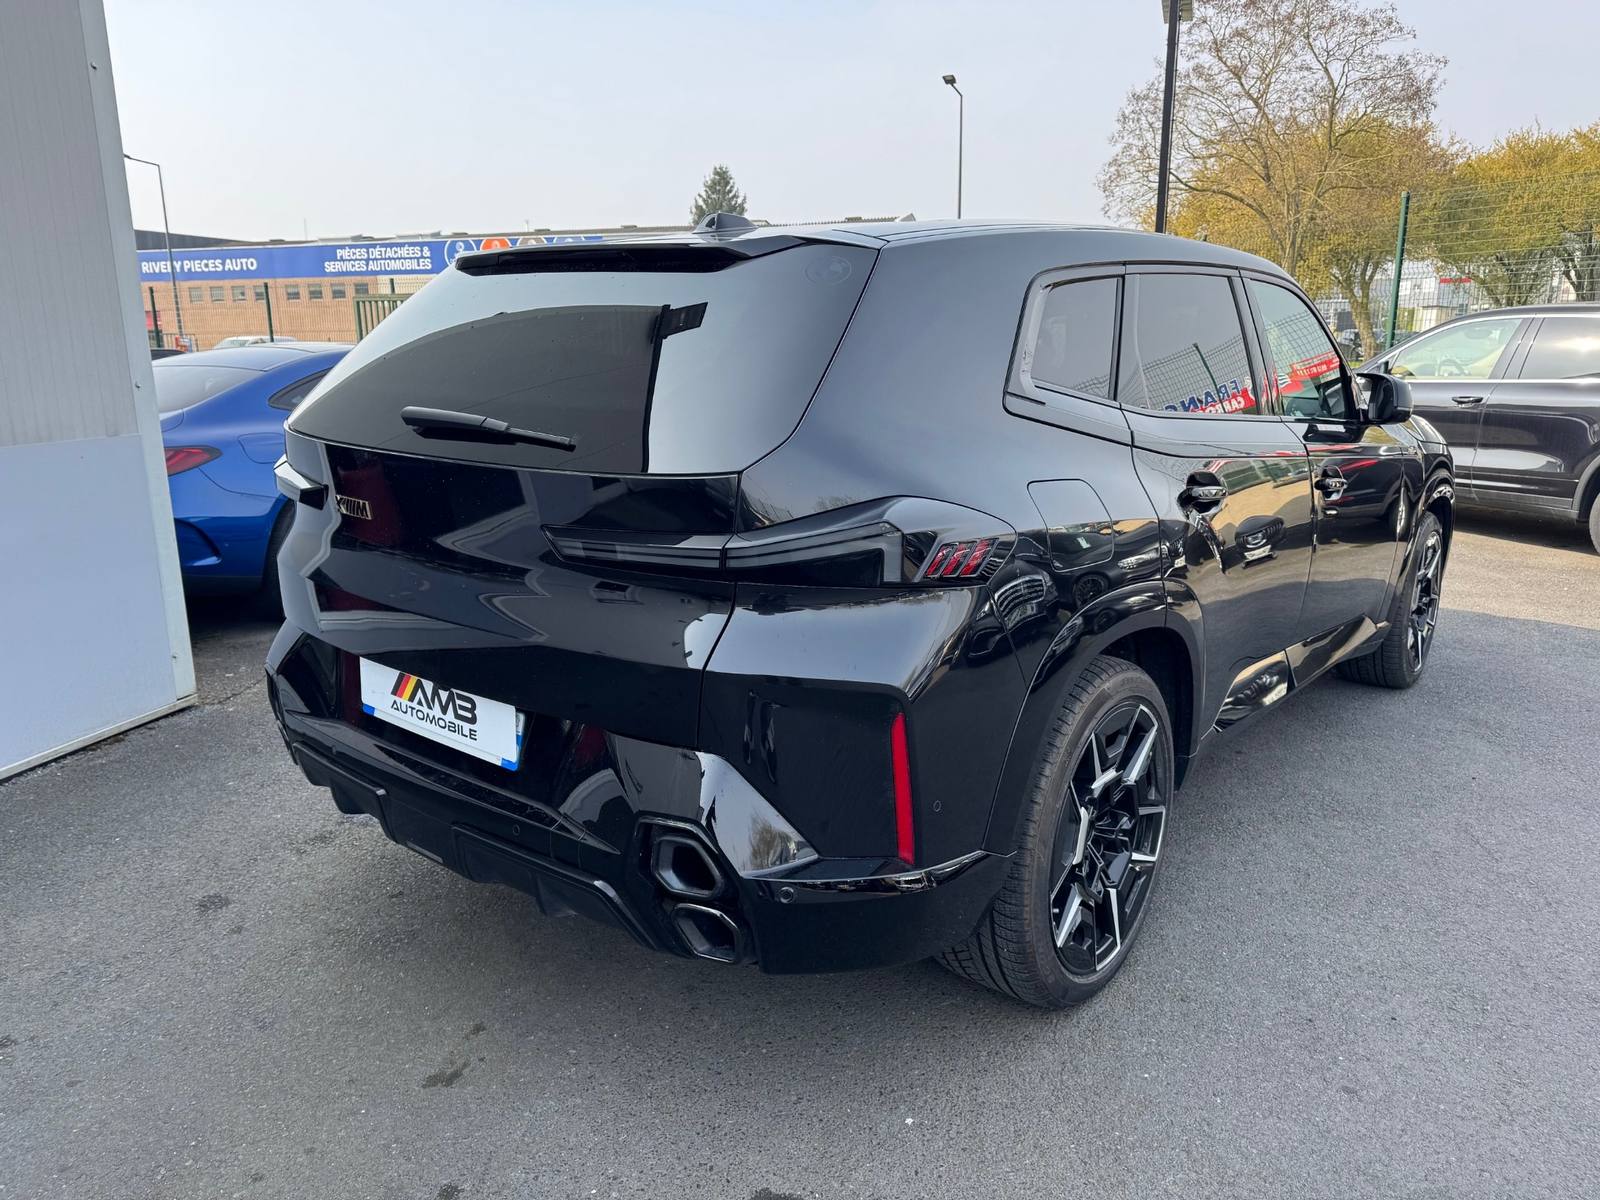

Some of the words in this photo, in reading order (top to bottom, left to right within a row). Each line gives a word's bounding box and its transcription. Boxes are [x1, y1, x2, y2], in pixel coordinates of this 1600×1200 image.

[336, 246, 367, 260] PIÈCES
[368, 244, 421, 259] DÉTACHÉES
[422, 246, 432, 258] &
[183, 259, 223, 273] PIECES
[224, 258, 258, 271] AUTO
[324, 260, 367, 273] SERVICES
[367, 258, 433, 272] AUTOMOBILES
[390, 700, 478, 741] AUTOMOBILE
